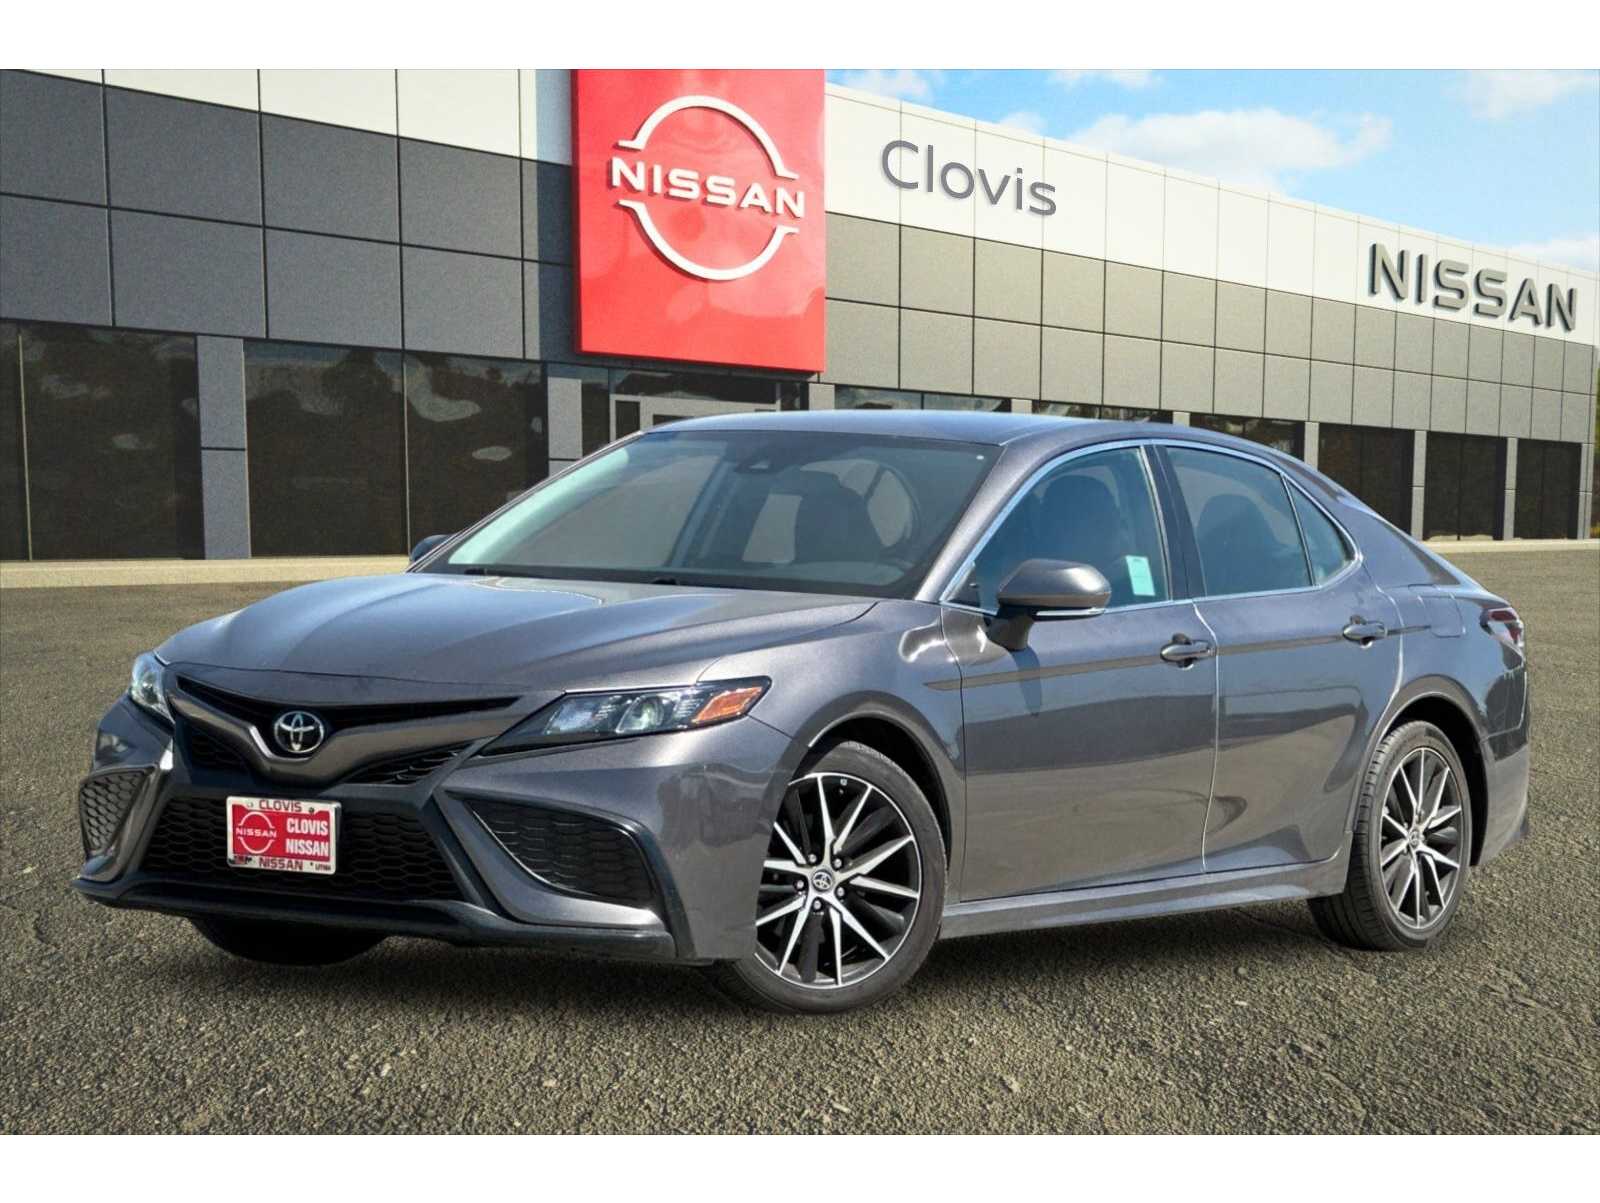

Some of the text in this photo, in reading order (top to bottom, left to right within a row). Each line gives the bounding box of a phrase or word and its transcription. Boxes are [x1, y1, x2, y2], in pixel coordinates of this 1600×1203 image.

[610, 155, 806, 218] NISSAN
[881, 140, 1057, 216] Clovis
[1369, 243, 1578, 332] NISSAN
[258, 799, 303, 812] CLOVIS
[235, 827, 277, 838] NISSAN
[286, 817, 329, 836] CLOVIS
[285, 838, 329, 857] NISSAN
[258, 856, 304, 871] NISSAN
